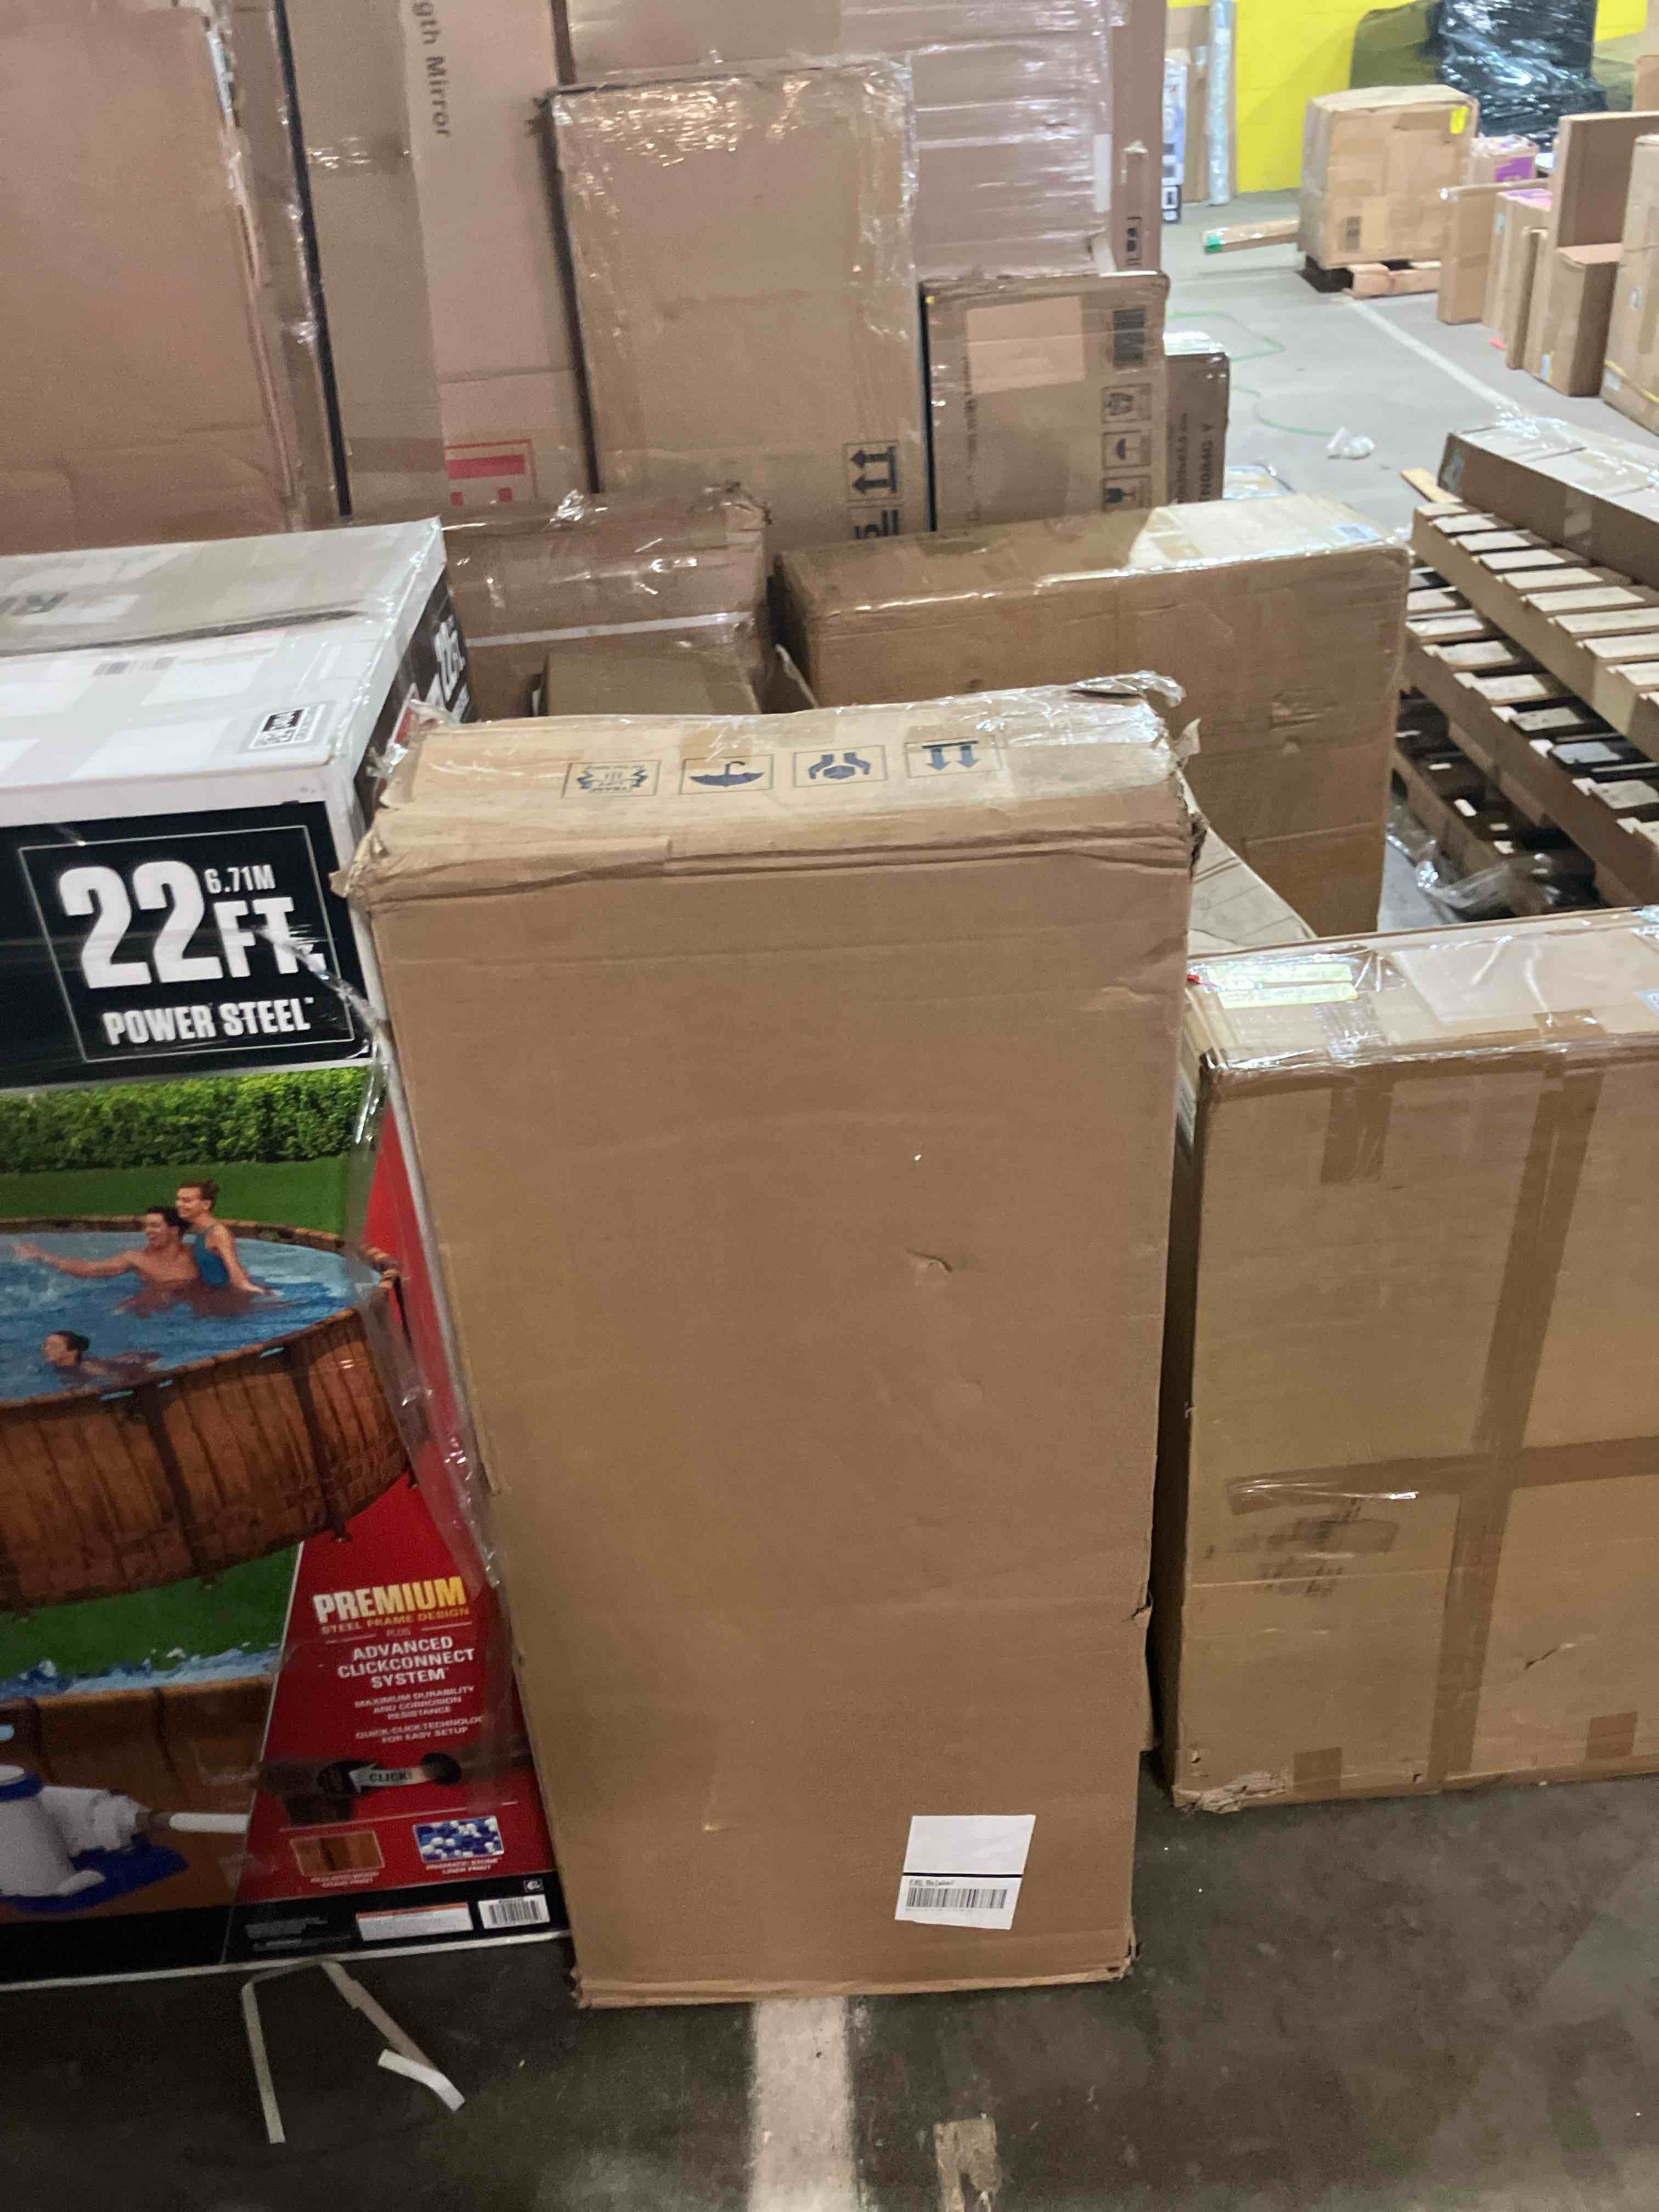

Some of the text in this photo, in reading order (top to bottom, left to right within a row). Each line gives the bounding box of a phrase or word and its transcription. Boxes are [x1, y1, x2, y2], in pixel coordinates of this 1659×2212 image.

[426, 56, 451, 138] Mirror
[204, 864, 276, 894] 6.71M
[102, 1003, 217, 1046] POWER
[313, 1576, 466, 1624] PREMIUM
[321, 1606, 470, 1635] STEEL FRAME DESIGN
[353, 1635, 454, 1661] ADVANCED
[337, 1647, 476, 1679] CLICKCONNECT
[354, 1685, 475, 1708] MAXIMUM DURABILITY
[373, 1696, 462, 1714] AND CORROSION
[387, 1706, 452, 1720] RESISTANCE
[435, 1726, 469, 1737] SETUP
